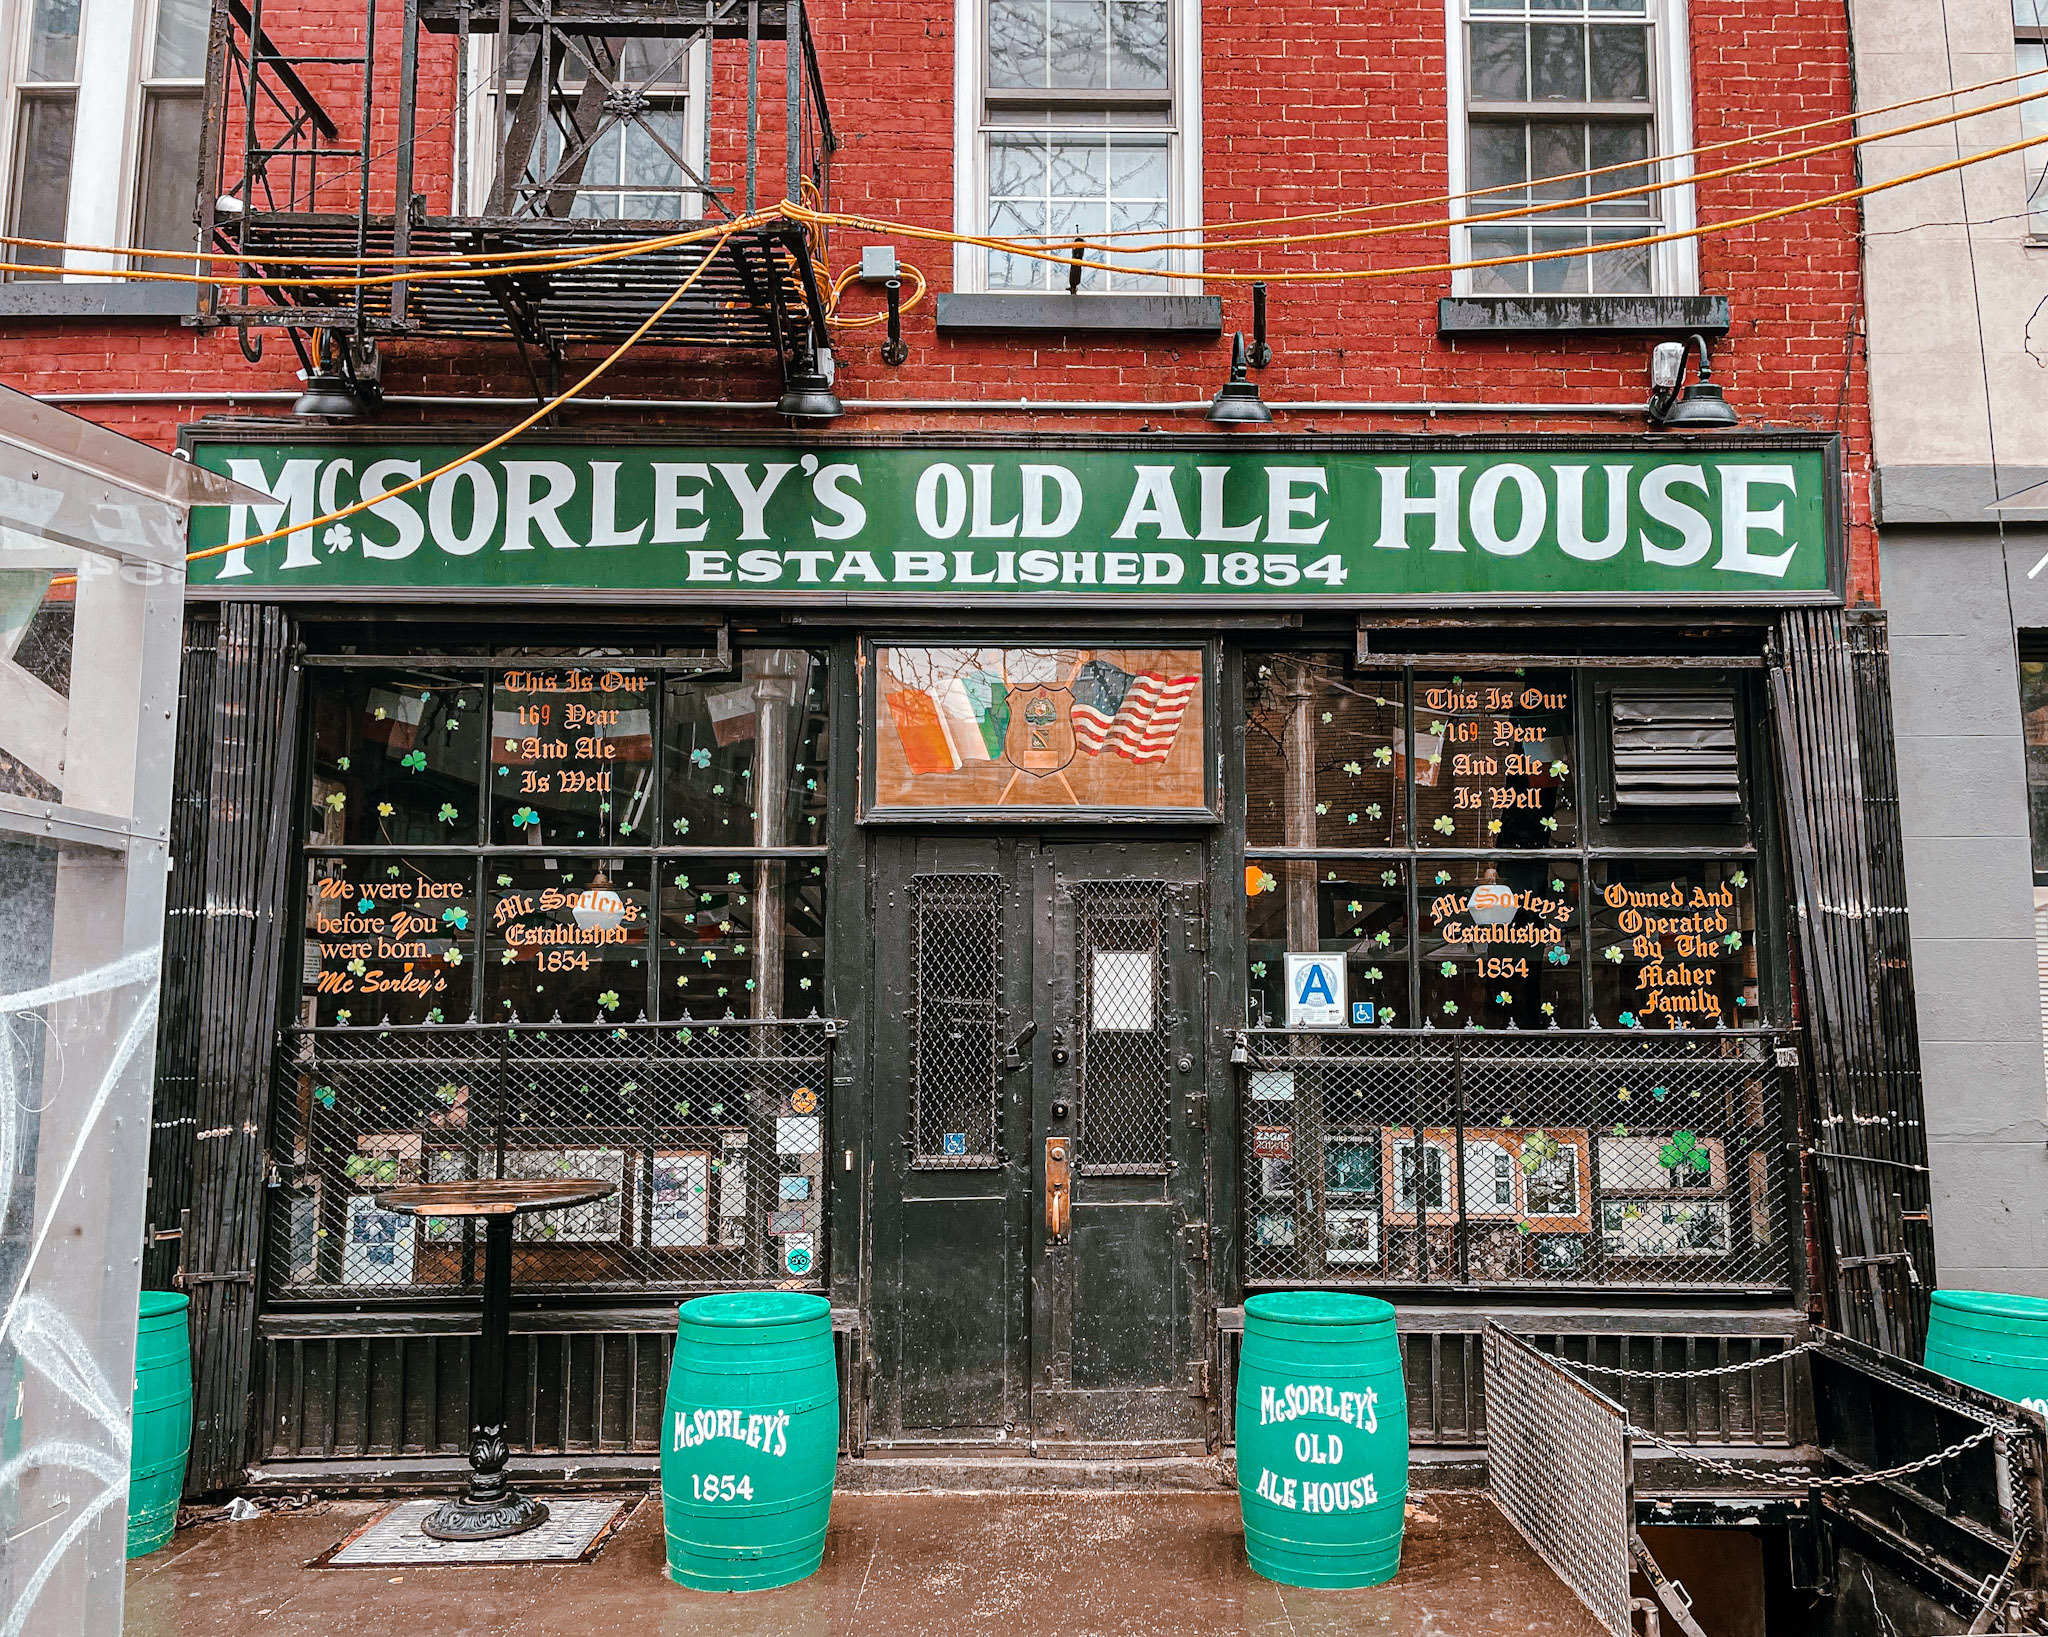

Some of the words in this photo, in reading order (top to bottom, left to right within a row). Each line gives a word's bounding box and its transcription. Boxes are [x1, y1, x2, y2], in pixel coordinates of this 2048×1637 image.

[915, 462, 1083, 540] OLD
[1110, 465, 1330, 545] ALE
[1373, 462, 1799, 578] HOUSE
[685, 549, 1186, 584] ESTABLISHED
[1200, 551, 1349, 587] 1854
[504, 670, 557, 695] This
[564, 670, 594, 693] Is
[600, 671, 649, 692] Our
[1425, 688, 1478, 713] This
[1485, 688, 1514, 710] Is
[1519, 688, 1567, 710] Our
[518, 704, 551, 726] 169
[565, 703, 620, 730] Year
[1447, 721, 1478, 743] 169
[1493, 720, 1547, 746] Year
[521, 736, 568, 760] And
[575, 737, 616, 760] Ale
[1453, 753, 1498, 776] And
[1505, 753, 1543, 776] Ale
[521, 770, 551, 793] Is
[558, 770, 611, 793] Well
[1453, 787, 1482, 809] Is
[1489, 787, 1542, 809] Well
[318, 878, 355, 899] We
[359, 883, 412, 899] were
[417, 877, 464, 899] here
[1604, 882, 1684, 909] Owned
[1688, 881, 1734, 908] And
[493, 895, 535, 928] Mc
[540, 887, 642, 922] Sorley's
[1430, 894, 1468, 926] Mc
[1474, 887, 1574, 922] Sorley's
[316, 911, 385, 935] before
[390, 911, 438, 940] You
[505, 923, 629, 948] Established
[1442, 920, 1562, 947] Established
[1618, 908, 1728, 938] Operated
[319, 943, 372, 959] were
[377, 936, 432, 959] born.
[1632, 934, 1664, 965] By
[1674, 934, 1719, 958] The
[536, 950, 590, 973] 1854
[1476, 957, 1529, 979] 1854
[316, 970, 354, 994] Mc
[360, 969, 448, 998] Sorley's
[1298, 964, 1335, 1005] A
[1635, 962, 1716, 990] Maher
[1638, 987, 1722, 1019] Family
[1664, 1014, 1696, 1031] Ic.
[1295, 1432, 1343, 1465] OLD
[692, 1474, 754, 1502] 1854
[1256, 1467, 1298, 1510] ALE
[1302, 1473, 1378, 1513] HOUSE
